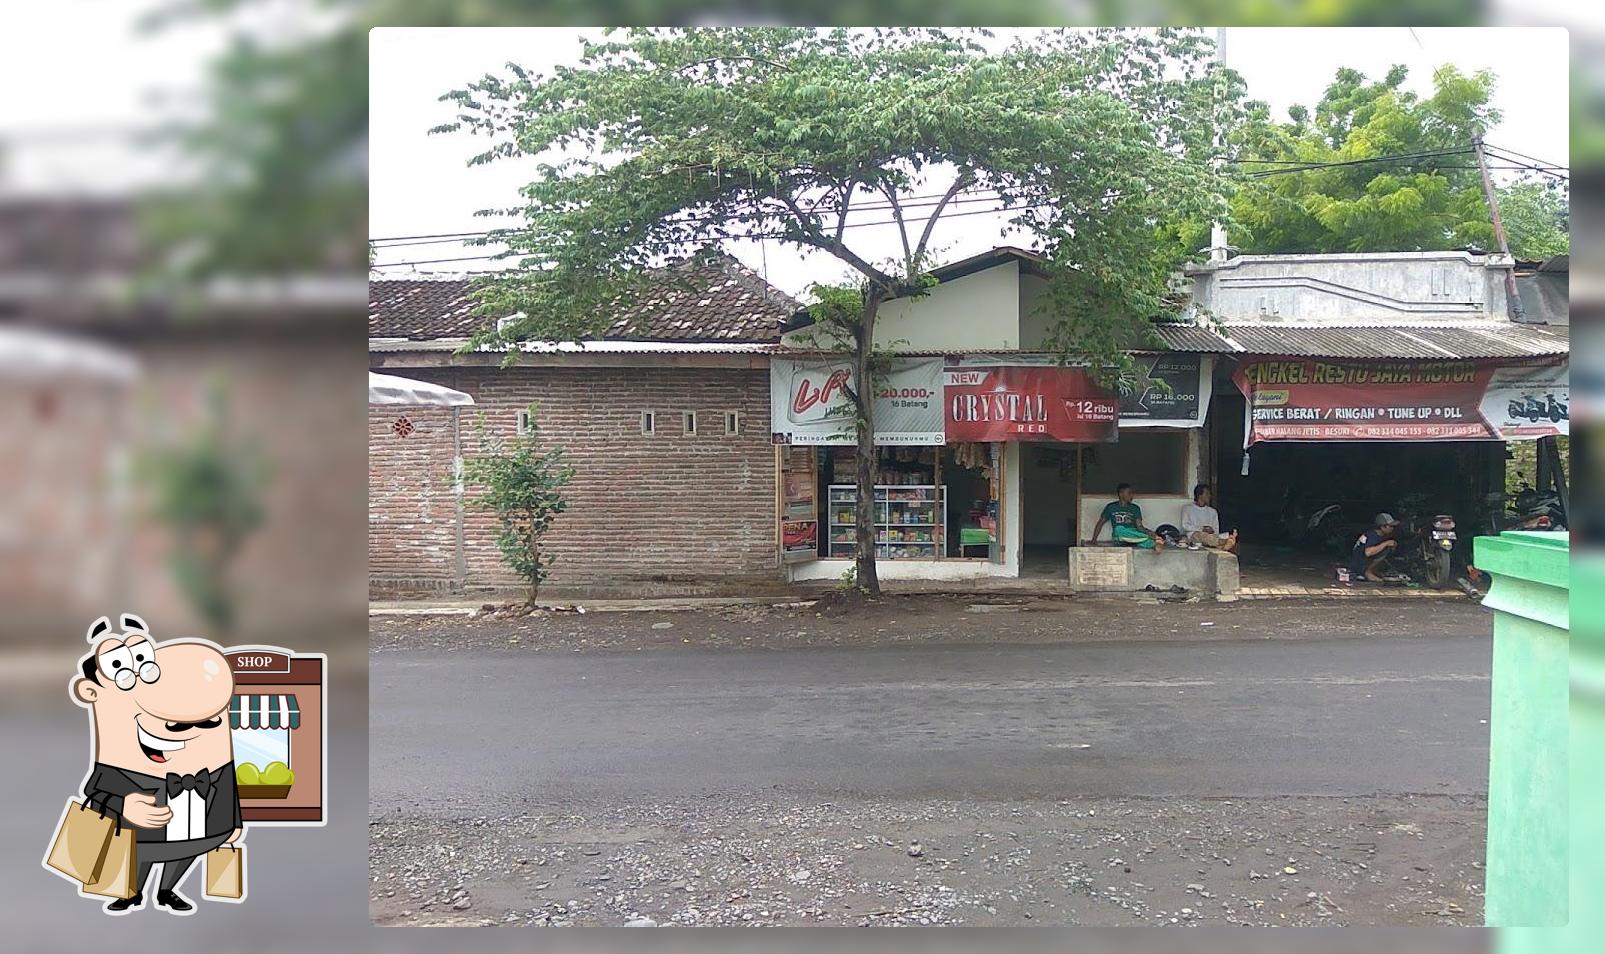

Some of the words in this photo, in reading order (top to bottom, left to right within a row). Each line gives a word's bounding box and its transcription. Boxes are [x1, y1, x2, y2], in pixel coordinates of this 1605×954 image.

[951, 373, 979, 384] NEW
[1312, 363, 1368, 384] RESTU
[1416, 362, 1476, 384] MOTOR
[901, 401, 928, 409] Batang
[952, 394, 1048, 422] CRYSTAL
[1077, 401, 1093, 413] 12
[1094, 405, 1114, 413] ribu
[1287, 408, 1321, 420] BERAT
[1336, 408, 1375, 420] RINGAN
[1388, 408, 1415, 419] TUNE
[1417, 408, 1432, 419] UP
[1444, 408, 1463, 418] DLL
[1017, 424, 1046, 433] RED
